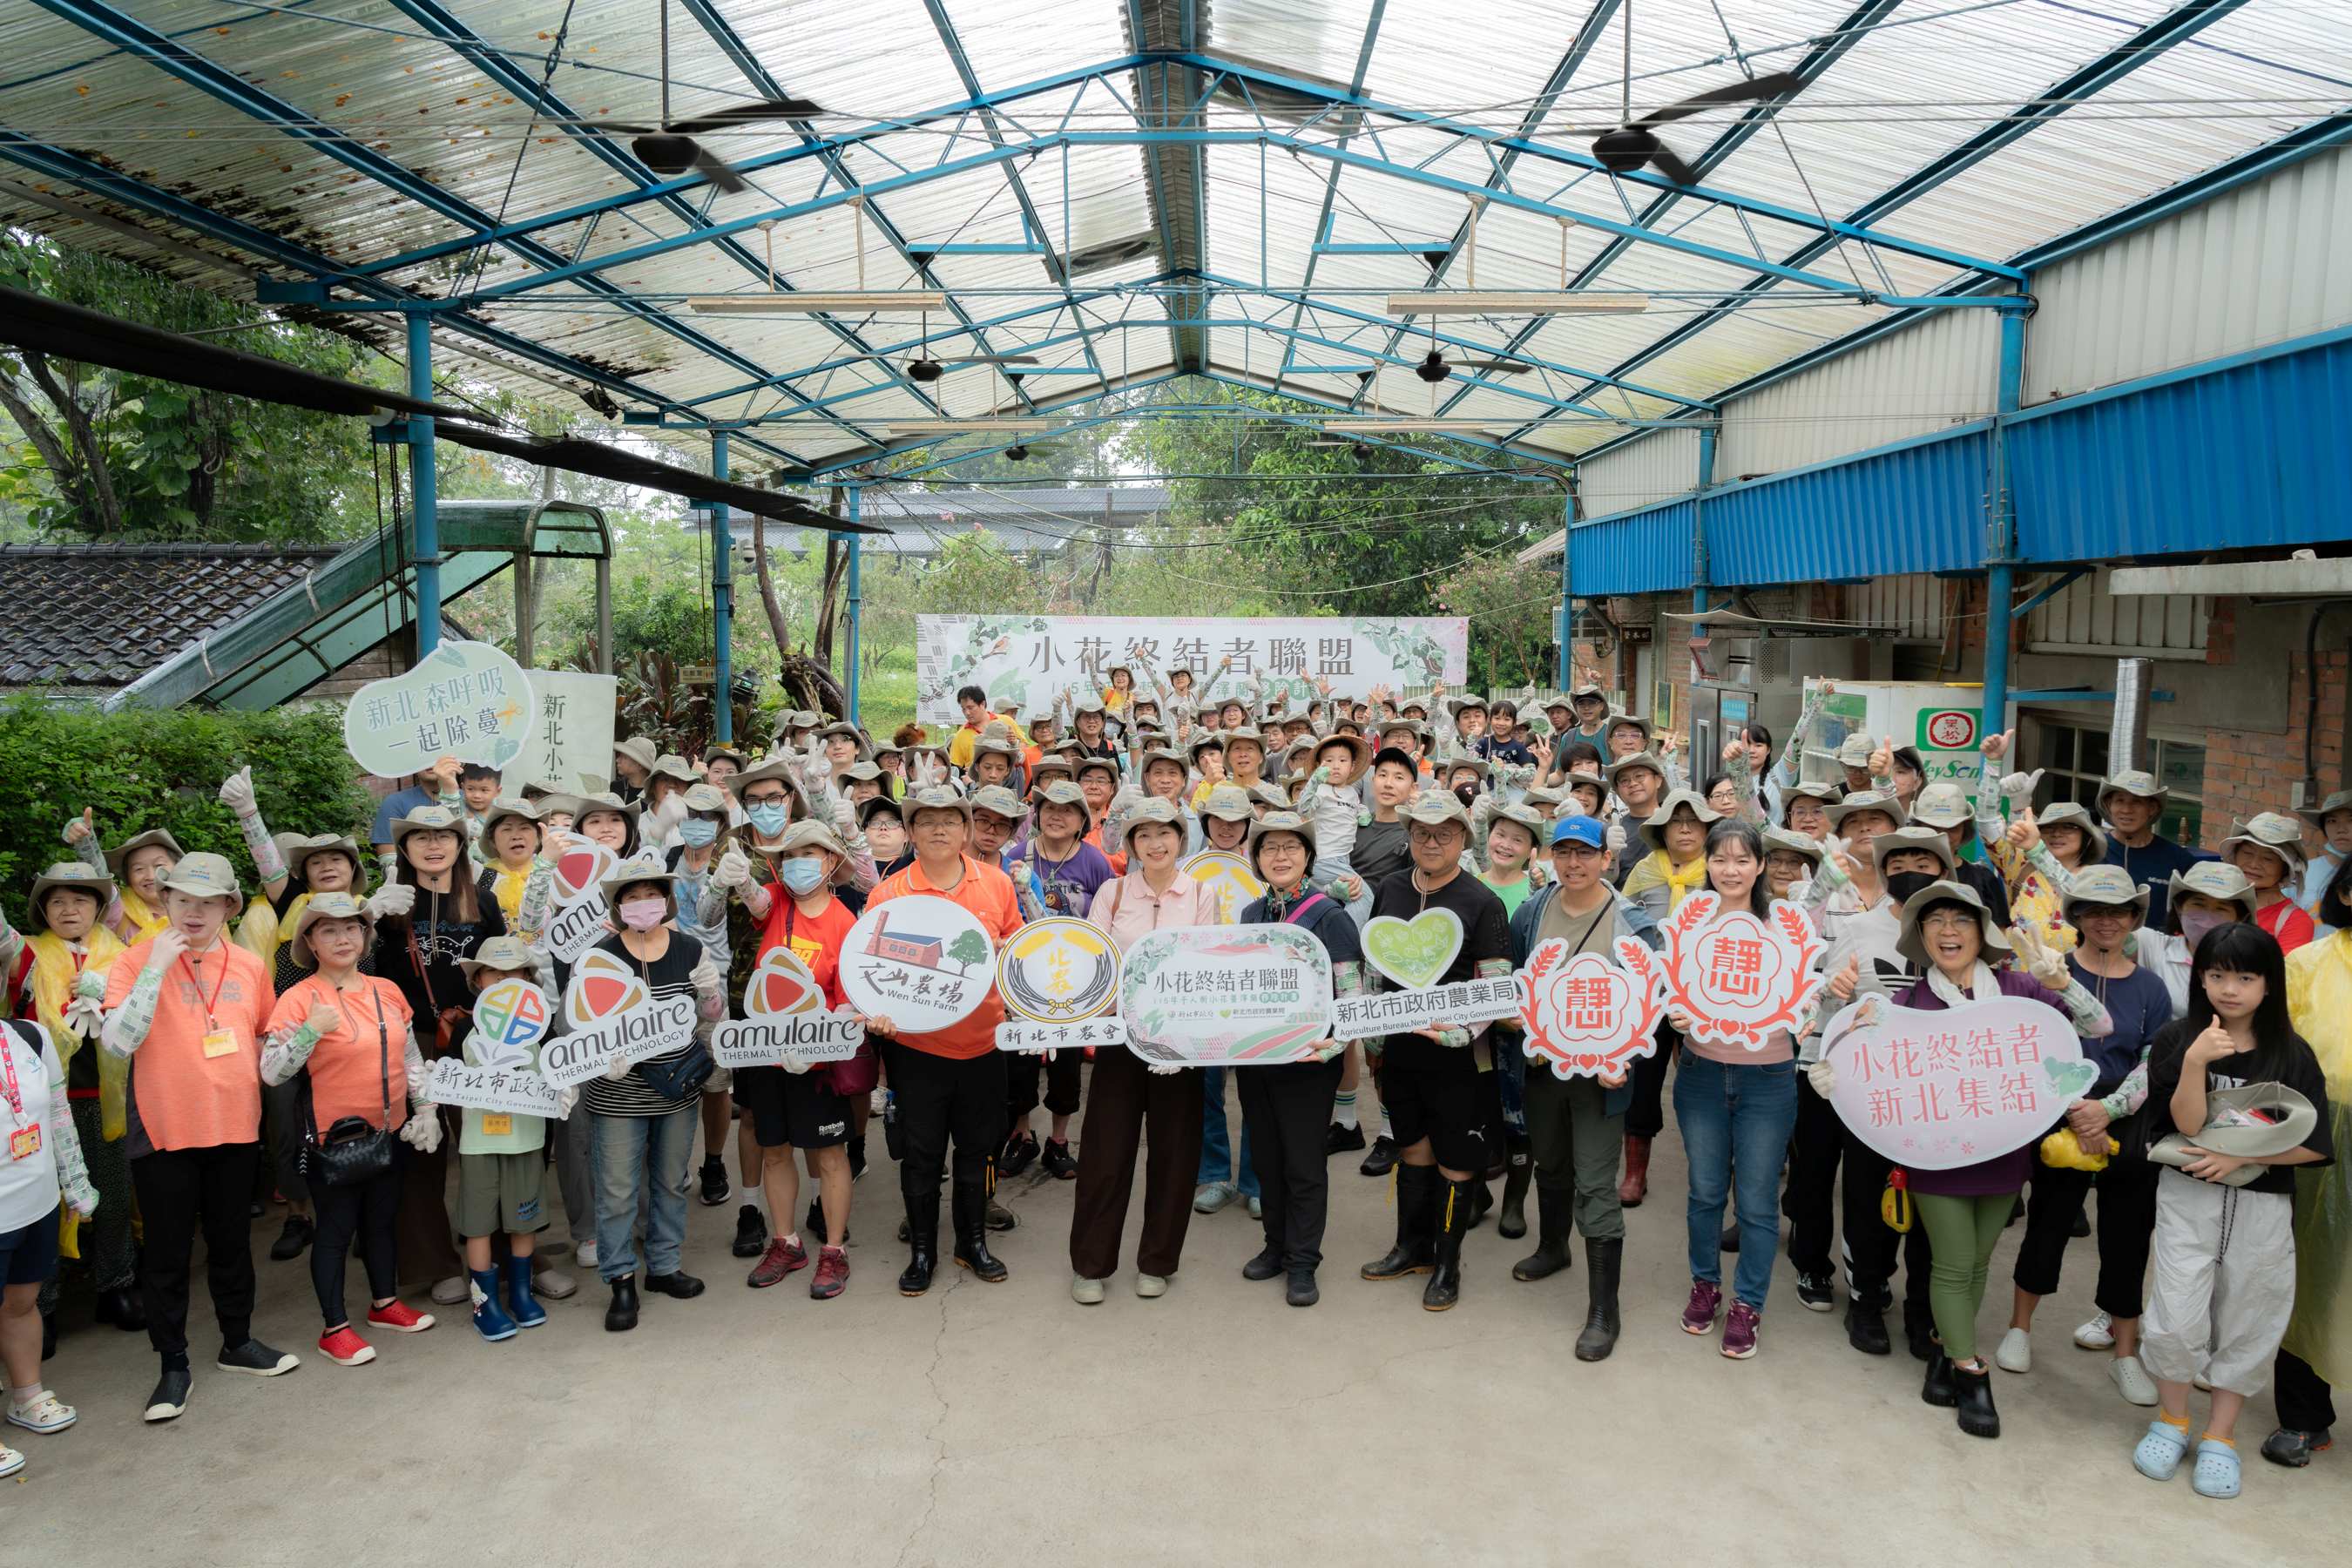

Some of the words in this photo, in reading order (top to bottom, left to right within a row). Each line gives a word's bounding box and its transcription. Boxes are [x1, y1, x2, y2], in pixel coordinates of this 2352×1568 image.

[1029, 635, 1354, 675] 小花終結者聯盟
[365, 666, 506, 731] 新北森呼吸
[388, 706, 501, 754] 一起除蔓
[858, 962, 963, 1004] 文山農場
[887, 989, 909, 1001] Wen
[911, 995, 931, 1006] Sun
[933, 1000, 958, 1013] Farm
[1154, 968, 1299, 994] 小花終結者聯盟
[1337, 981, 1515, 1024] 新北市政府農業局
[1340, 1024, 1382, 1037] Agriculture
[1453, 1009, 1469, 1023] City
[1470, 1006, 1517, 1018] Government
[549, 1002, 690, 1070] amulaire
[720, 1015, 858, 1049] amulaire
[1004, 1024, 1121, 1044] 新北市農會
[554, 1058, 607, 1082] THERMAL
[610, 1030, 685, 1058] CHNOLOGY
[723, 1049, 773, 1060] THERMAL
[1851, 1023, 2043, 1084] 小花終結者
[456, 1093, 482, 1102] Taipei
[485, 1097, 504, 1106] City
[506, 1100, 557, 1112] Government
[1868, 1071, 2037, 1128] 新北集結
